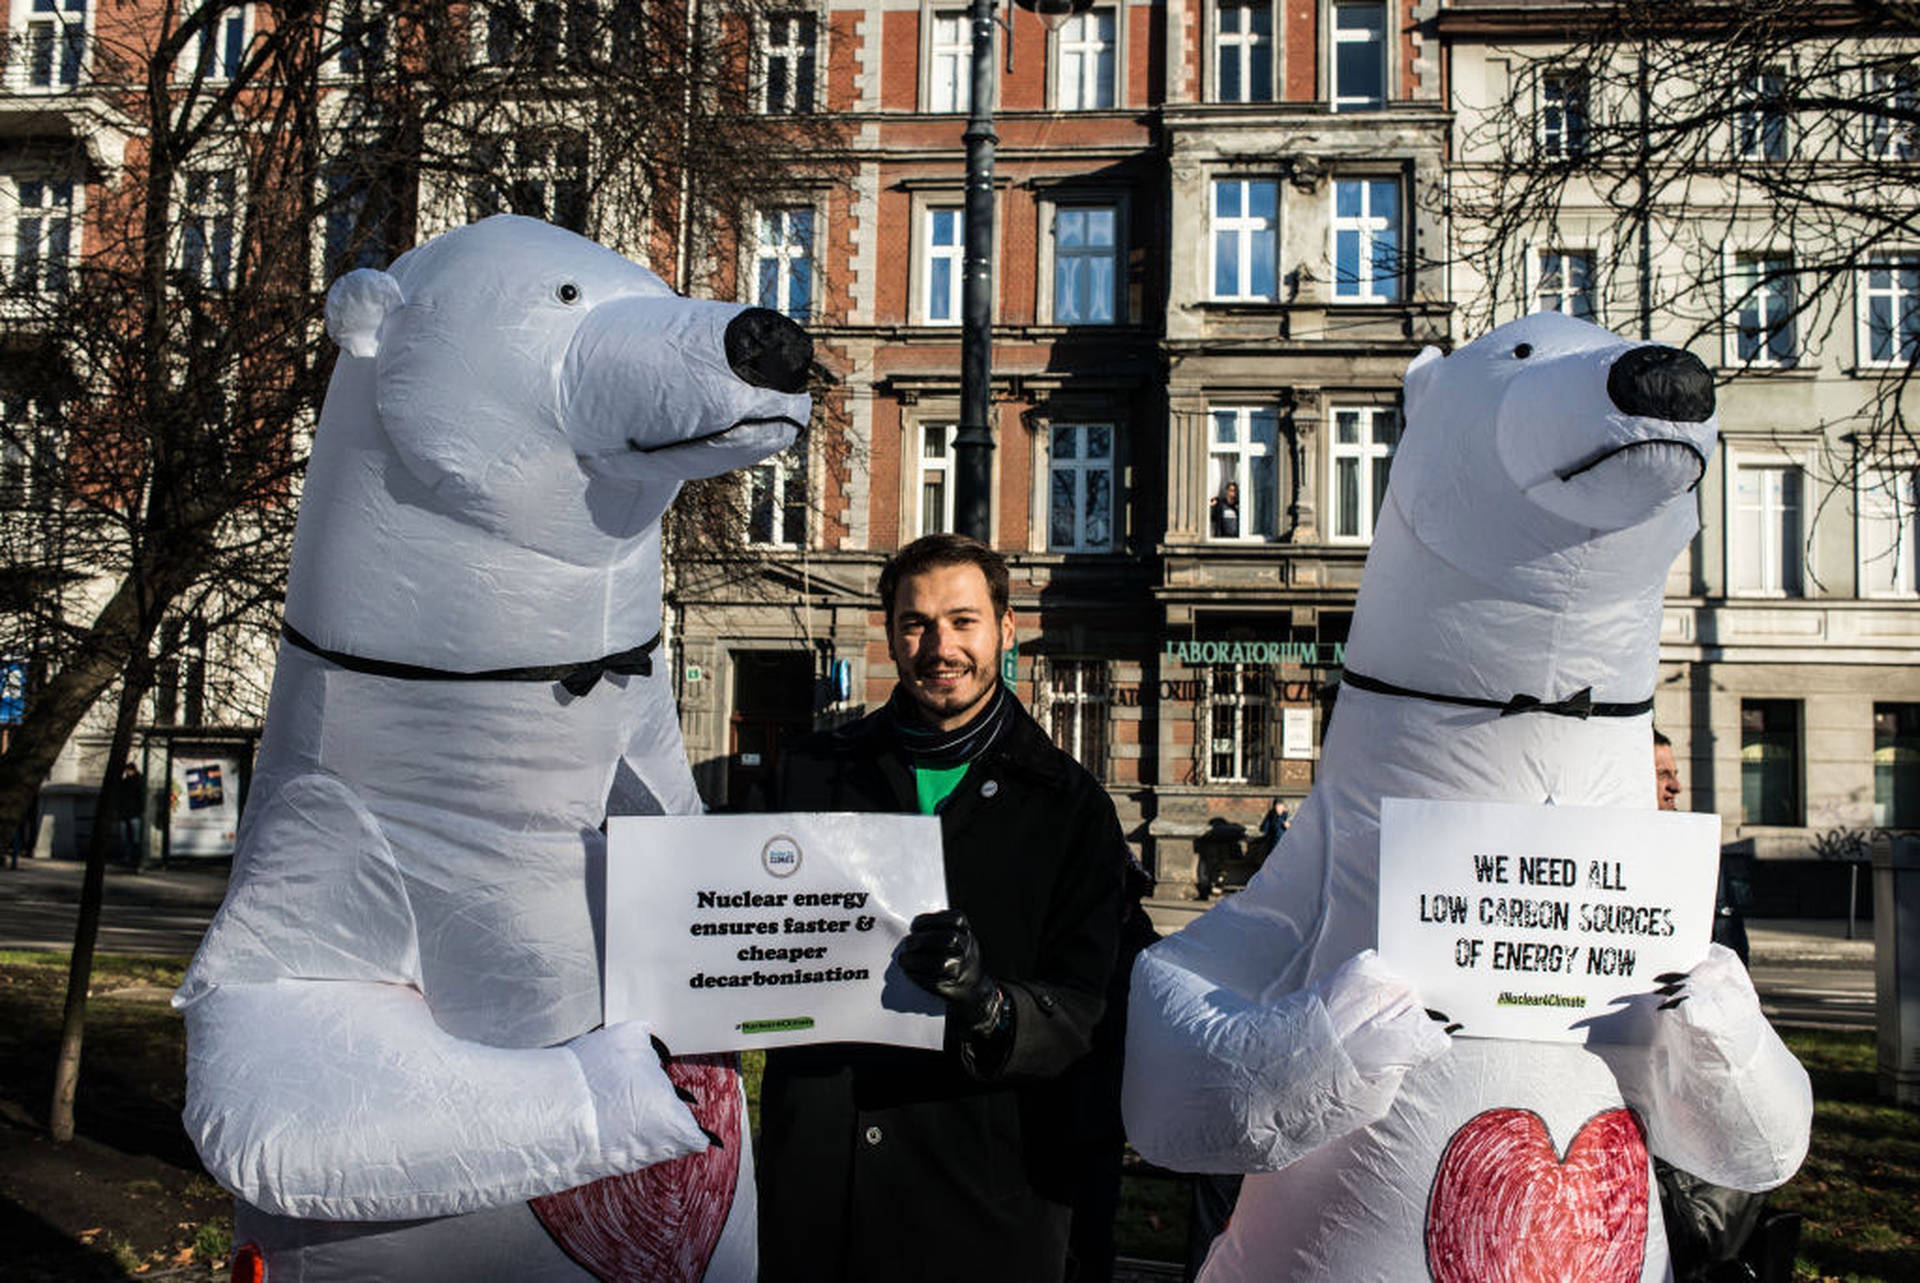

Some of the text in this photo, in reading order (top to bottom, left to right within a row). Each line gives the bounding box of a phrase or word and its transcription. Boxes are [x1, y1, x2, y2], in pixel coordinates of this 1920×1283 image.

[1166, 640, 1318, 664] LABORATORIUM
[1473, 854, 1628, 892] WE NEED ALL
[696, 890, 870, 911] Nuclear energy
[689, 914, 877, 937] ensures faster &
[1420, 894, 1676, 937] LOW CARBON SOURCES
[736, 944, 828, 965] cheaper
[1455, 938, 1637, 977] OF ENERGY NOW
[689, 966, 871, 989] decarbonisation
[1496, 991, 1587, 1010] #Nuclear4Climate
